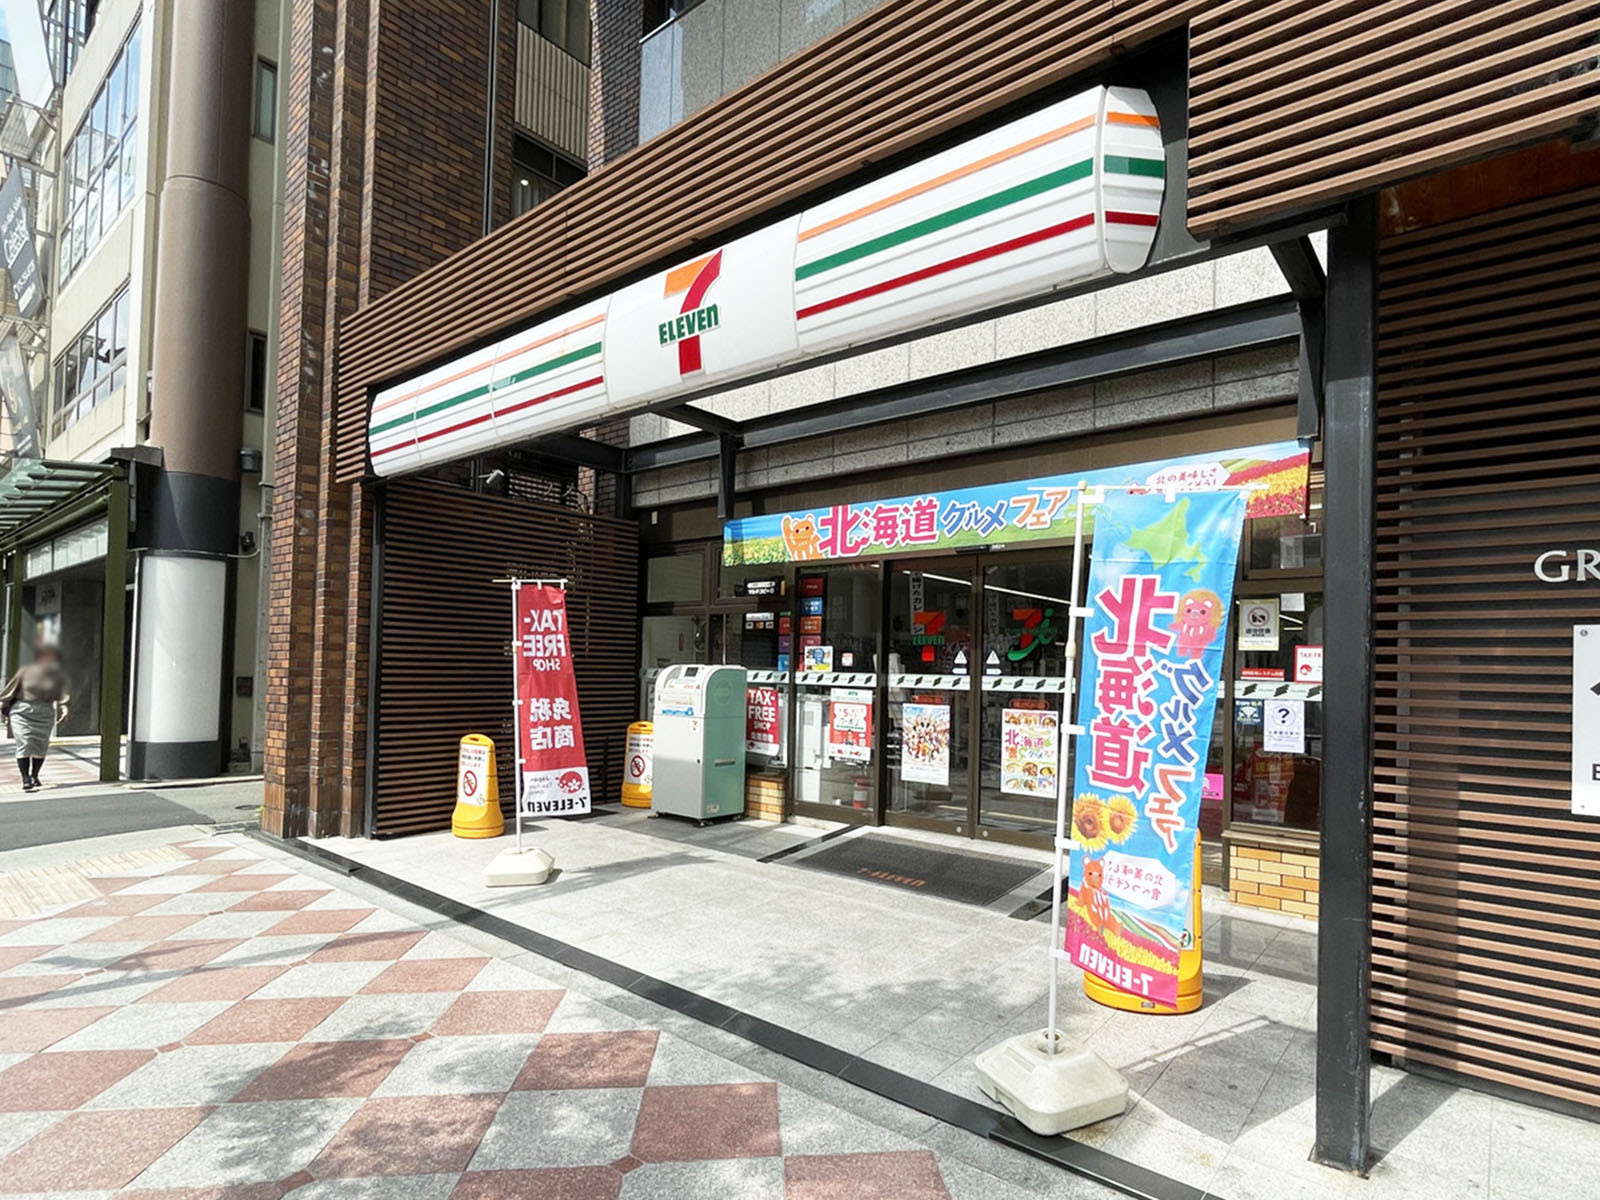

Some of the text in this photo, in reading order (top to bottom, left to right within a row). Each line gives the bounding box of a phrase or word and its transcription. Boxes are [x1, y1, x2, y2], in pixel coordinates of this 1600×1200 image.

[748, 688, 776, 706] TAX-
[748, 705, 776, 722] FREE
[754, 721, 771, 730] SHOP
[1005, 729, 1044, 748] 北海道
